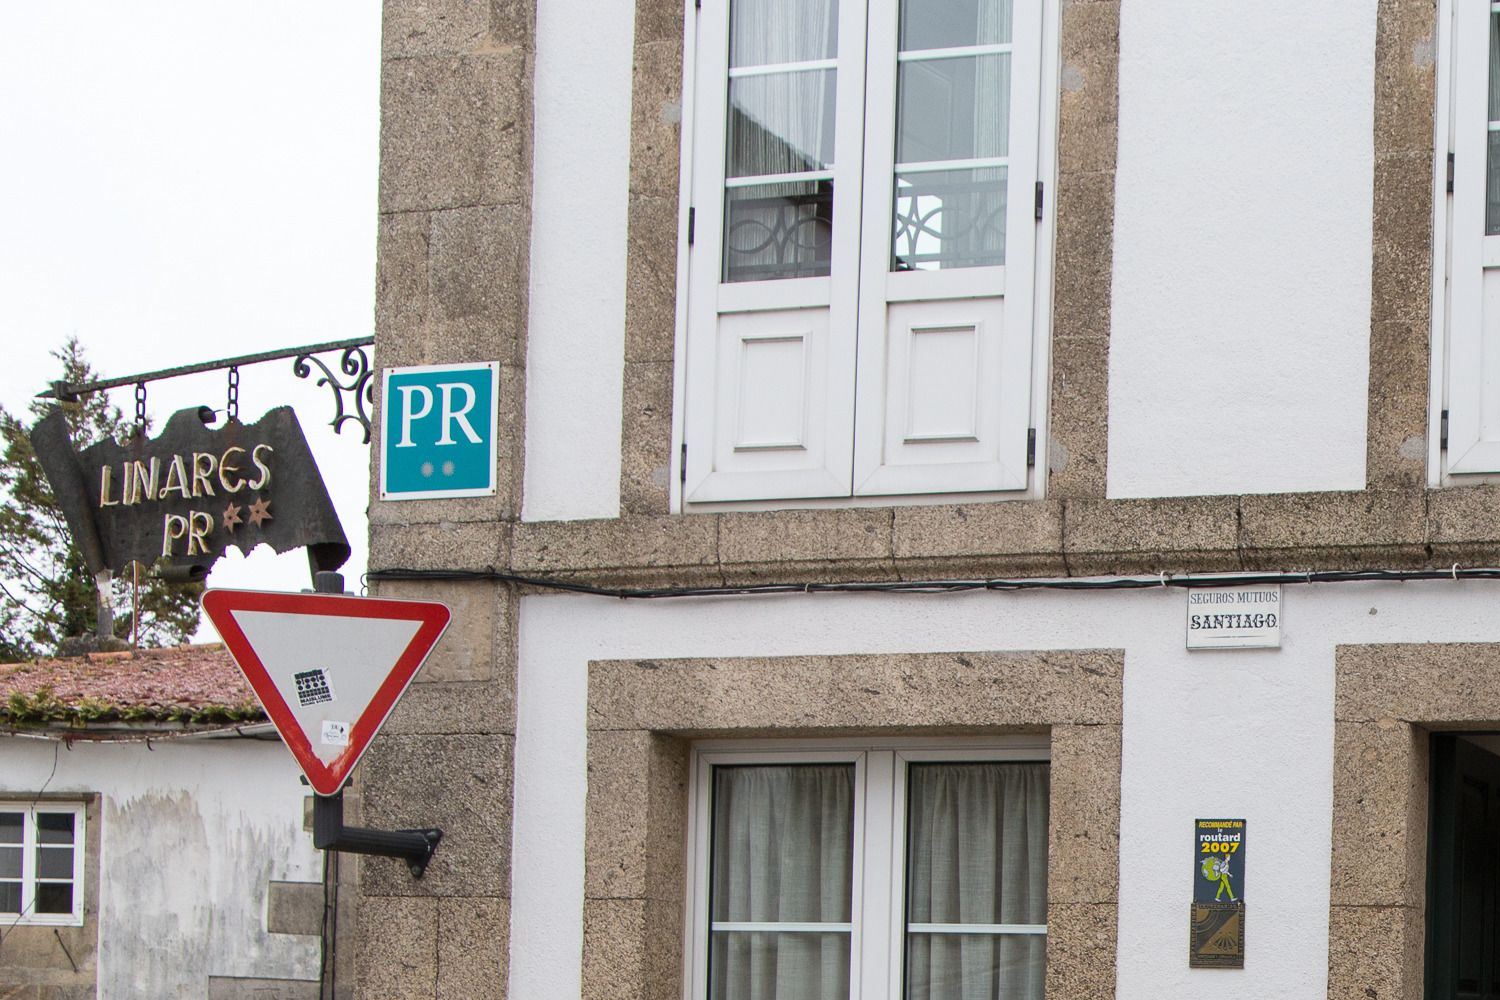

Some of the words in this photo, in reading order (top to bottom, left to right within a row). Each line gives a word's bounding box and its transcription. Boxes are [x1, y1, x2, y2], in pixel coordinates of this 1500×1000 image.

[395, 382, 483, 448] PR
[99, 443, 274, 508] LINARES
[162, 510, 214, 557] PR
[1190, 592, 1234, 604] SEGUROS
[1237, 591, 1278, 603] MUTUOS
[1200, 833, 1240, 841] routard
[1201, 842, 1240, 853] 2007
